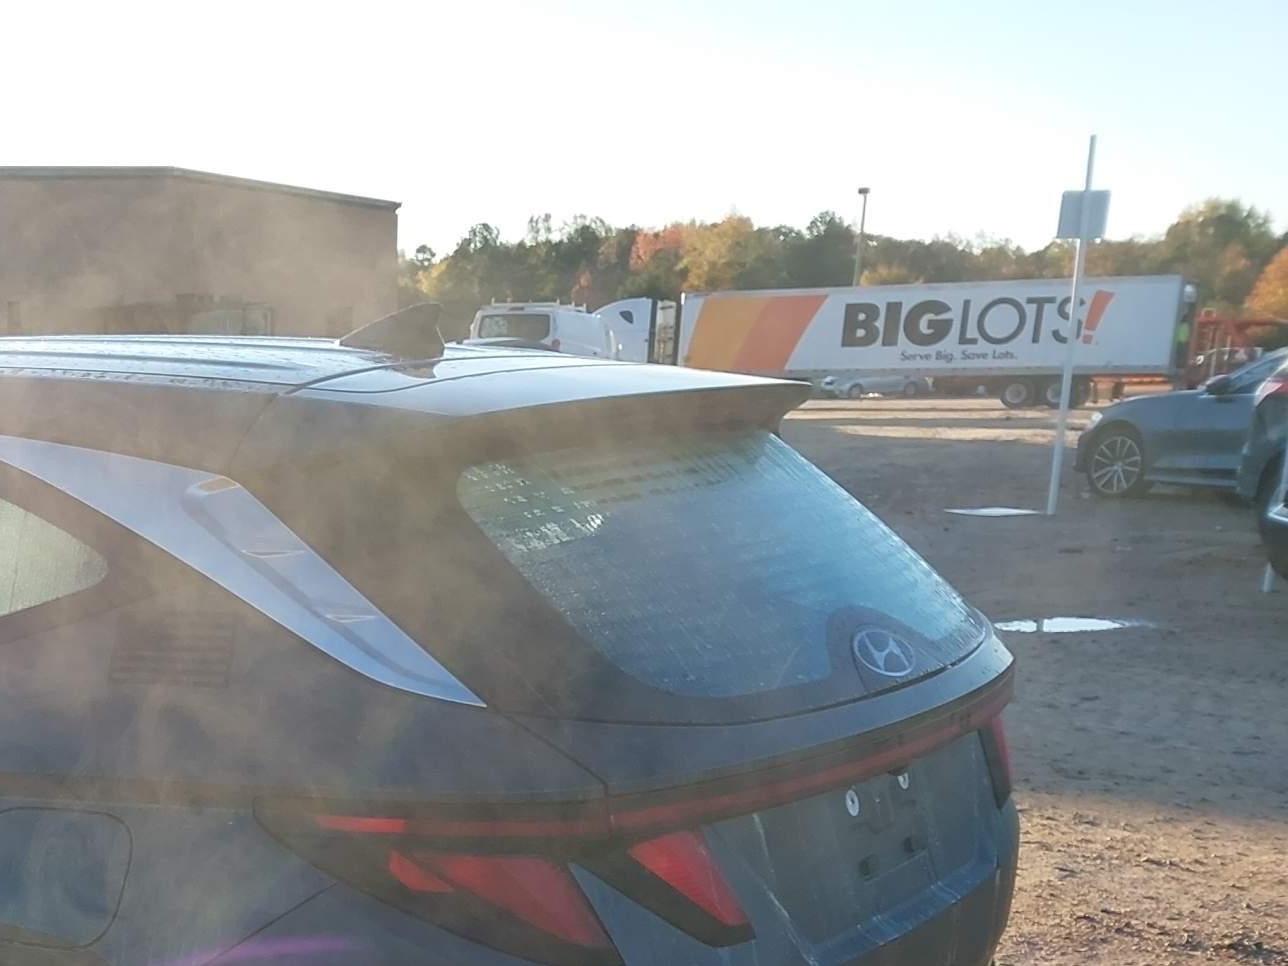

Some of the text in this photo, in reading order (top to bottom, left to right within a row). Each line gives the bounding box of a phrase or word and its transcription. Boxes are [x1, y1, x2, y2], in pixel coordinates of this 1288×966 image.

[841, 290, 1115, 348] BIG LOTS!
[900, 350, 1018, 363] Serve Big. Save Lots.
